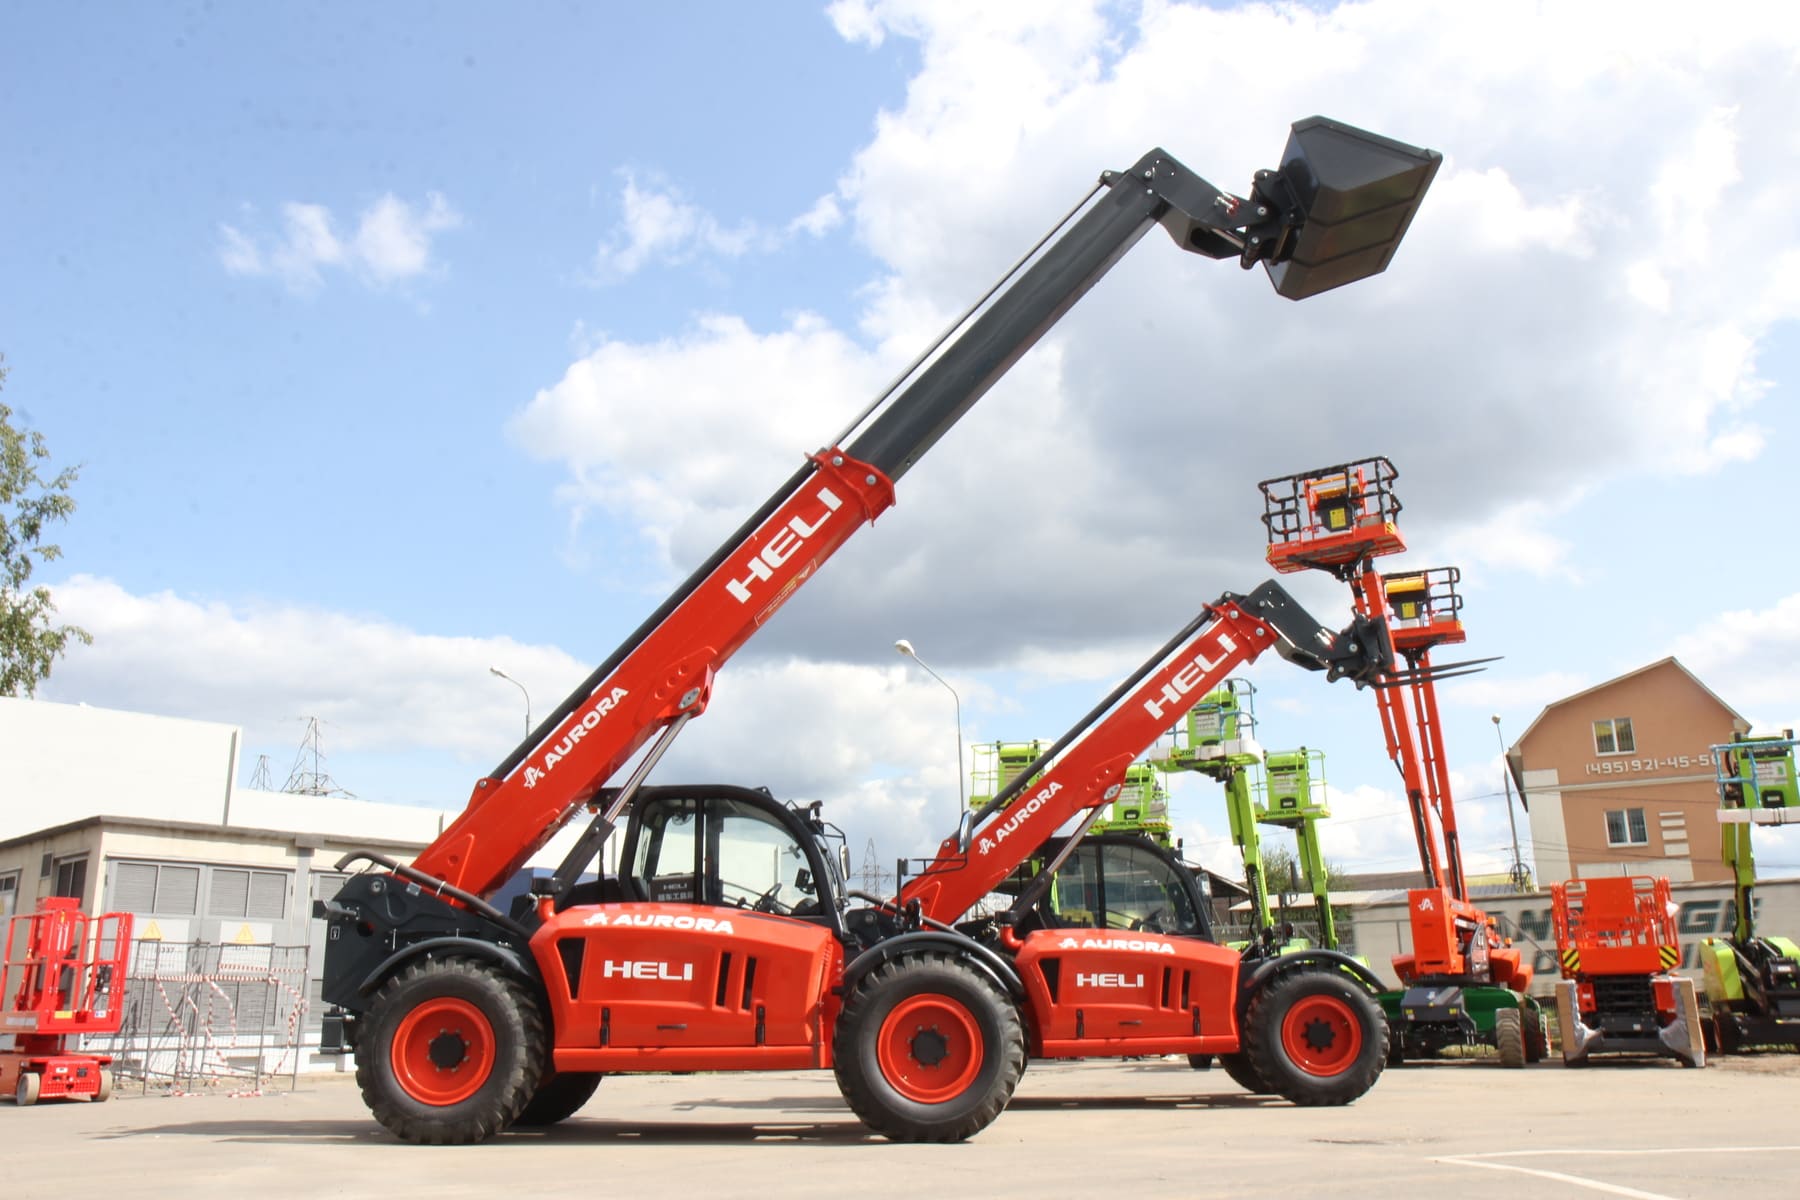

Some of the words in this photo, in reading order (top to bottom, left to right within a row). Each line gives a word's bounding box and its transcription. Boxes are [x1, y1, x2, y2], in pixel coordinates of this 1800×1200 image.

[725, 487, 843, 604] HELI
[1143, 633, 1238, 720] HELI
[544, 686, 628, 770] AURORA
[995, 781, 1063, 841] AURORA
[612, 913, 734, 935] AURORA
[1081, 938, 1176, 954] AURORA
[603, 960, 693, 981] HELI
[1076, 973, 1144, 988] HELI
